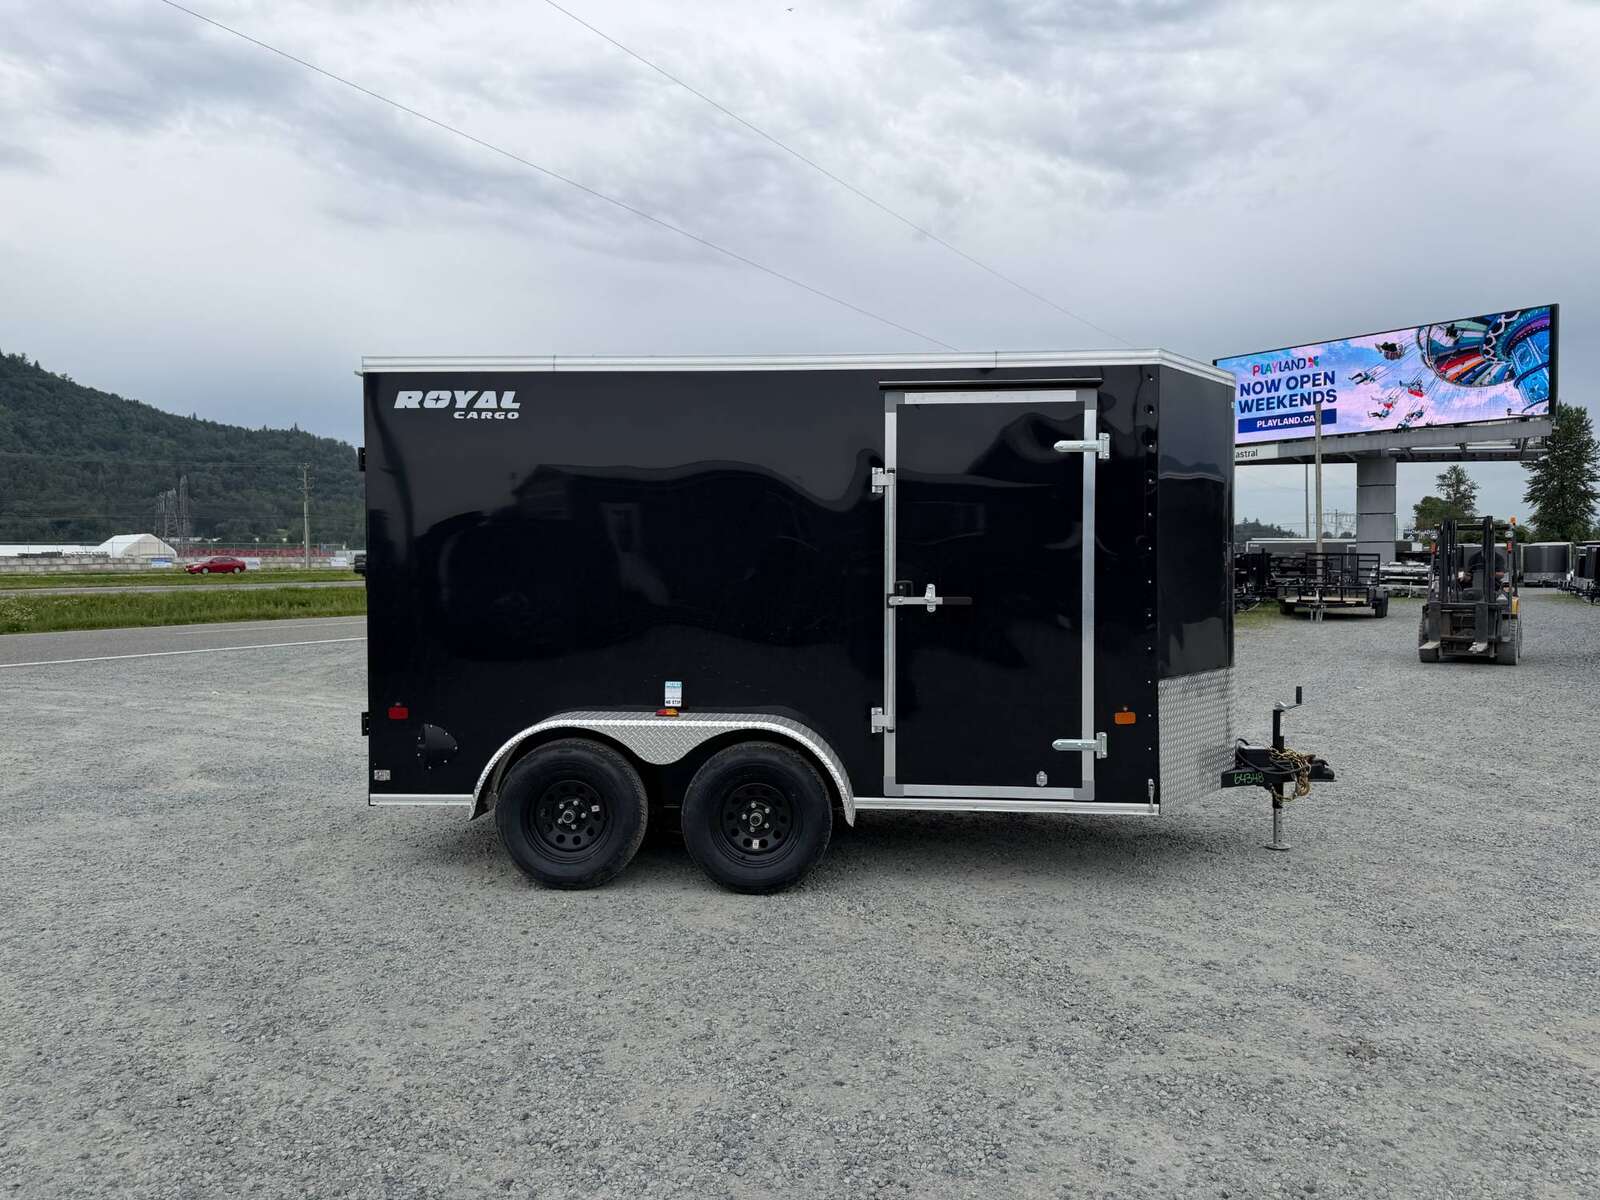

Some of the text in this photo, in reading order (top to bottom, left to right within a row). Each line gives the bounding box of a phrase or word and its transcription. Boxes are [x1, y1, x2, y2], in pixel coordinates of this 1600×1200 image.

[1252, 357, 1306, 377] PLAYLAND
[1240, 370, 1335, 397] NOW OPEN
[393, 390, 521, 409] ROYAL
[1238, 388, 1338, 414] WEEKENDS
[453, 411, 520, 420] CARGO
[1256, 415, 1315, 428] PLAYLAND.CA
[1234, 771, 1265, 785] 64348
